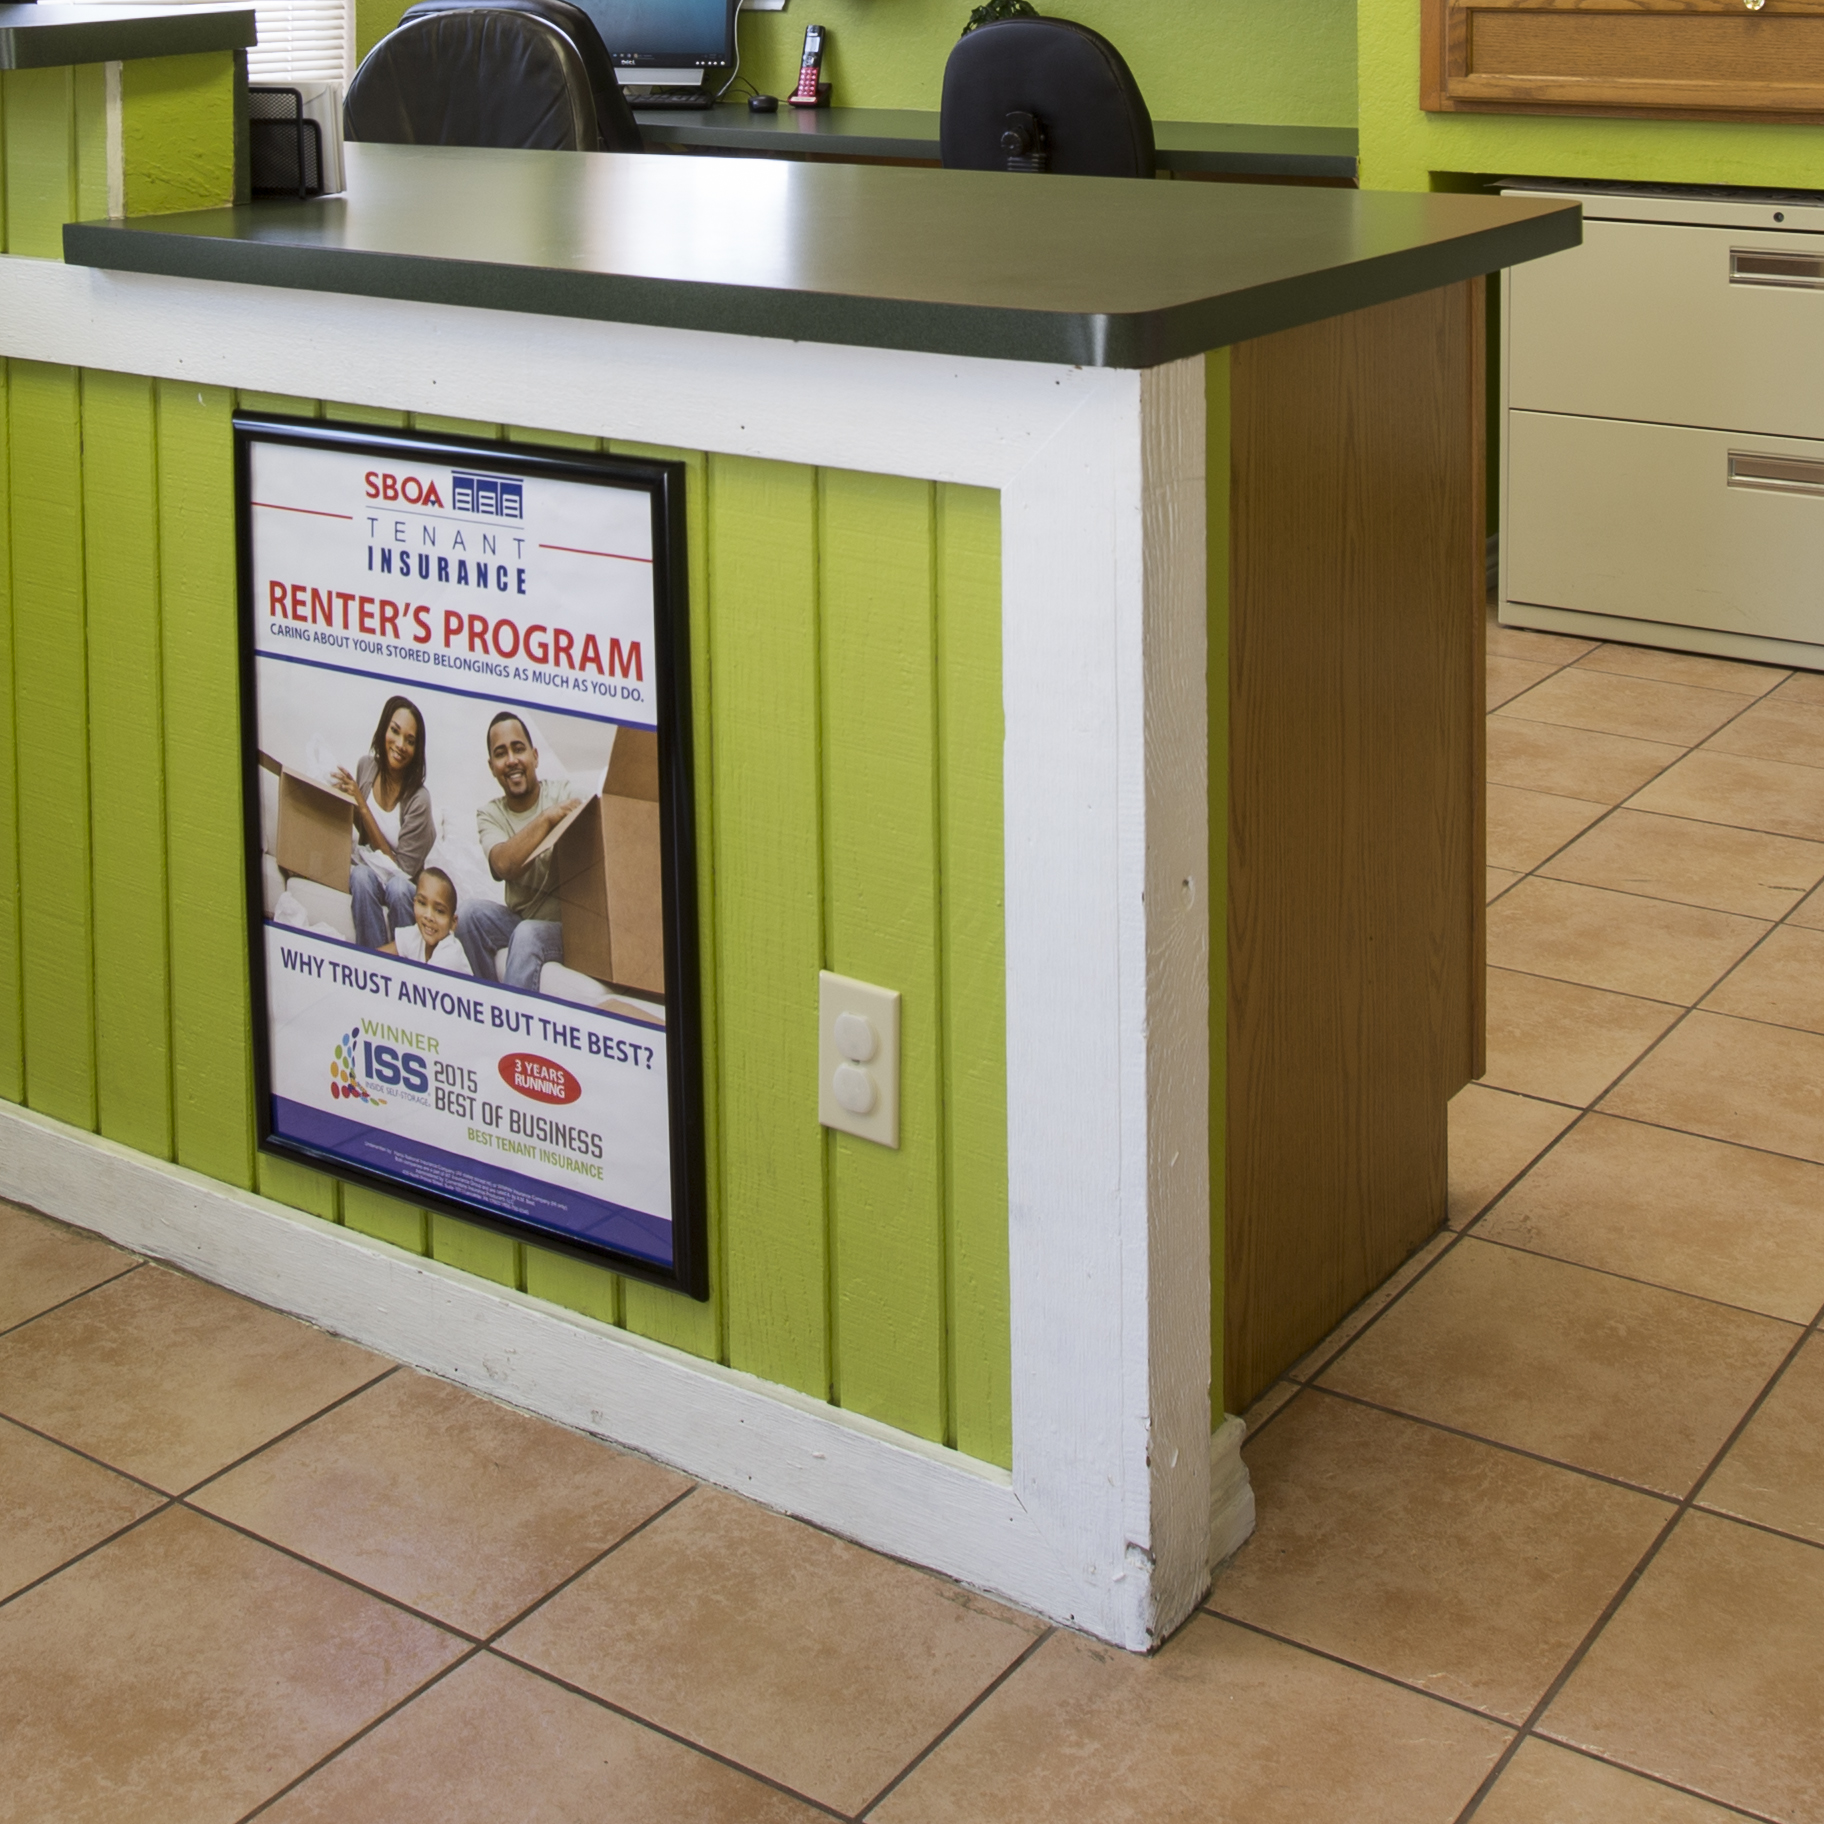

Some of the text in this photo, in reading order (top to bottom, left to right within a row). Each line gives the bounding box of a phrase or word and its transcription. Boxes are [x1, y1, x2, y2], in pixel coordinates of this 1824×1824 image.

[364, 471, 445, 509] SBOA
[367, 517, 526, 560] TENANT
[367, 546, 526, 596] INSURANCE
[269, 580, 644, 682] RENTER'S PROGRAM
[270, 623, 644, 702] CARING ABOUT YOUR STORED BELONGINGS AS MUCH AS YOU DO.
[280, 947, 654, 1070] WHY TRUST ANYONE BUT THE BEST?
[361, 1018, 440, 1054] WINNER
[364, 1040, 428, 1094] ISS
[365, 1081, 384, 1094] INSIDE
[434, 1060, 478, 1093] 2015
[514, 1059, 564, 1084] 3 YEARS
[514, 1073, 565, 1098] RUNNING
[435, 1086, 602, 1158] BEST OF BUSINESS
[468, 1127, 604, 1180] BEST TENANT INSURANCE
